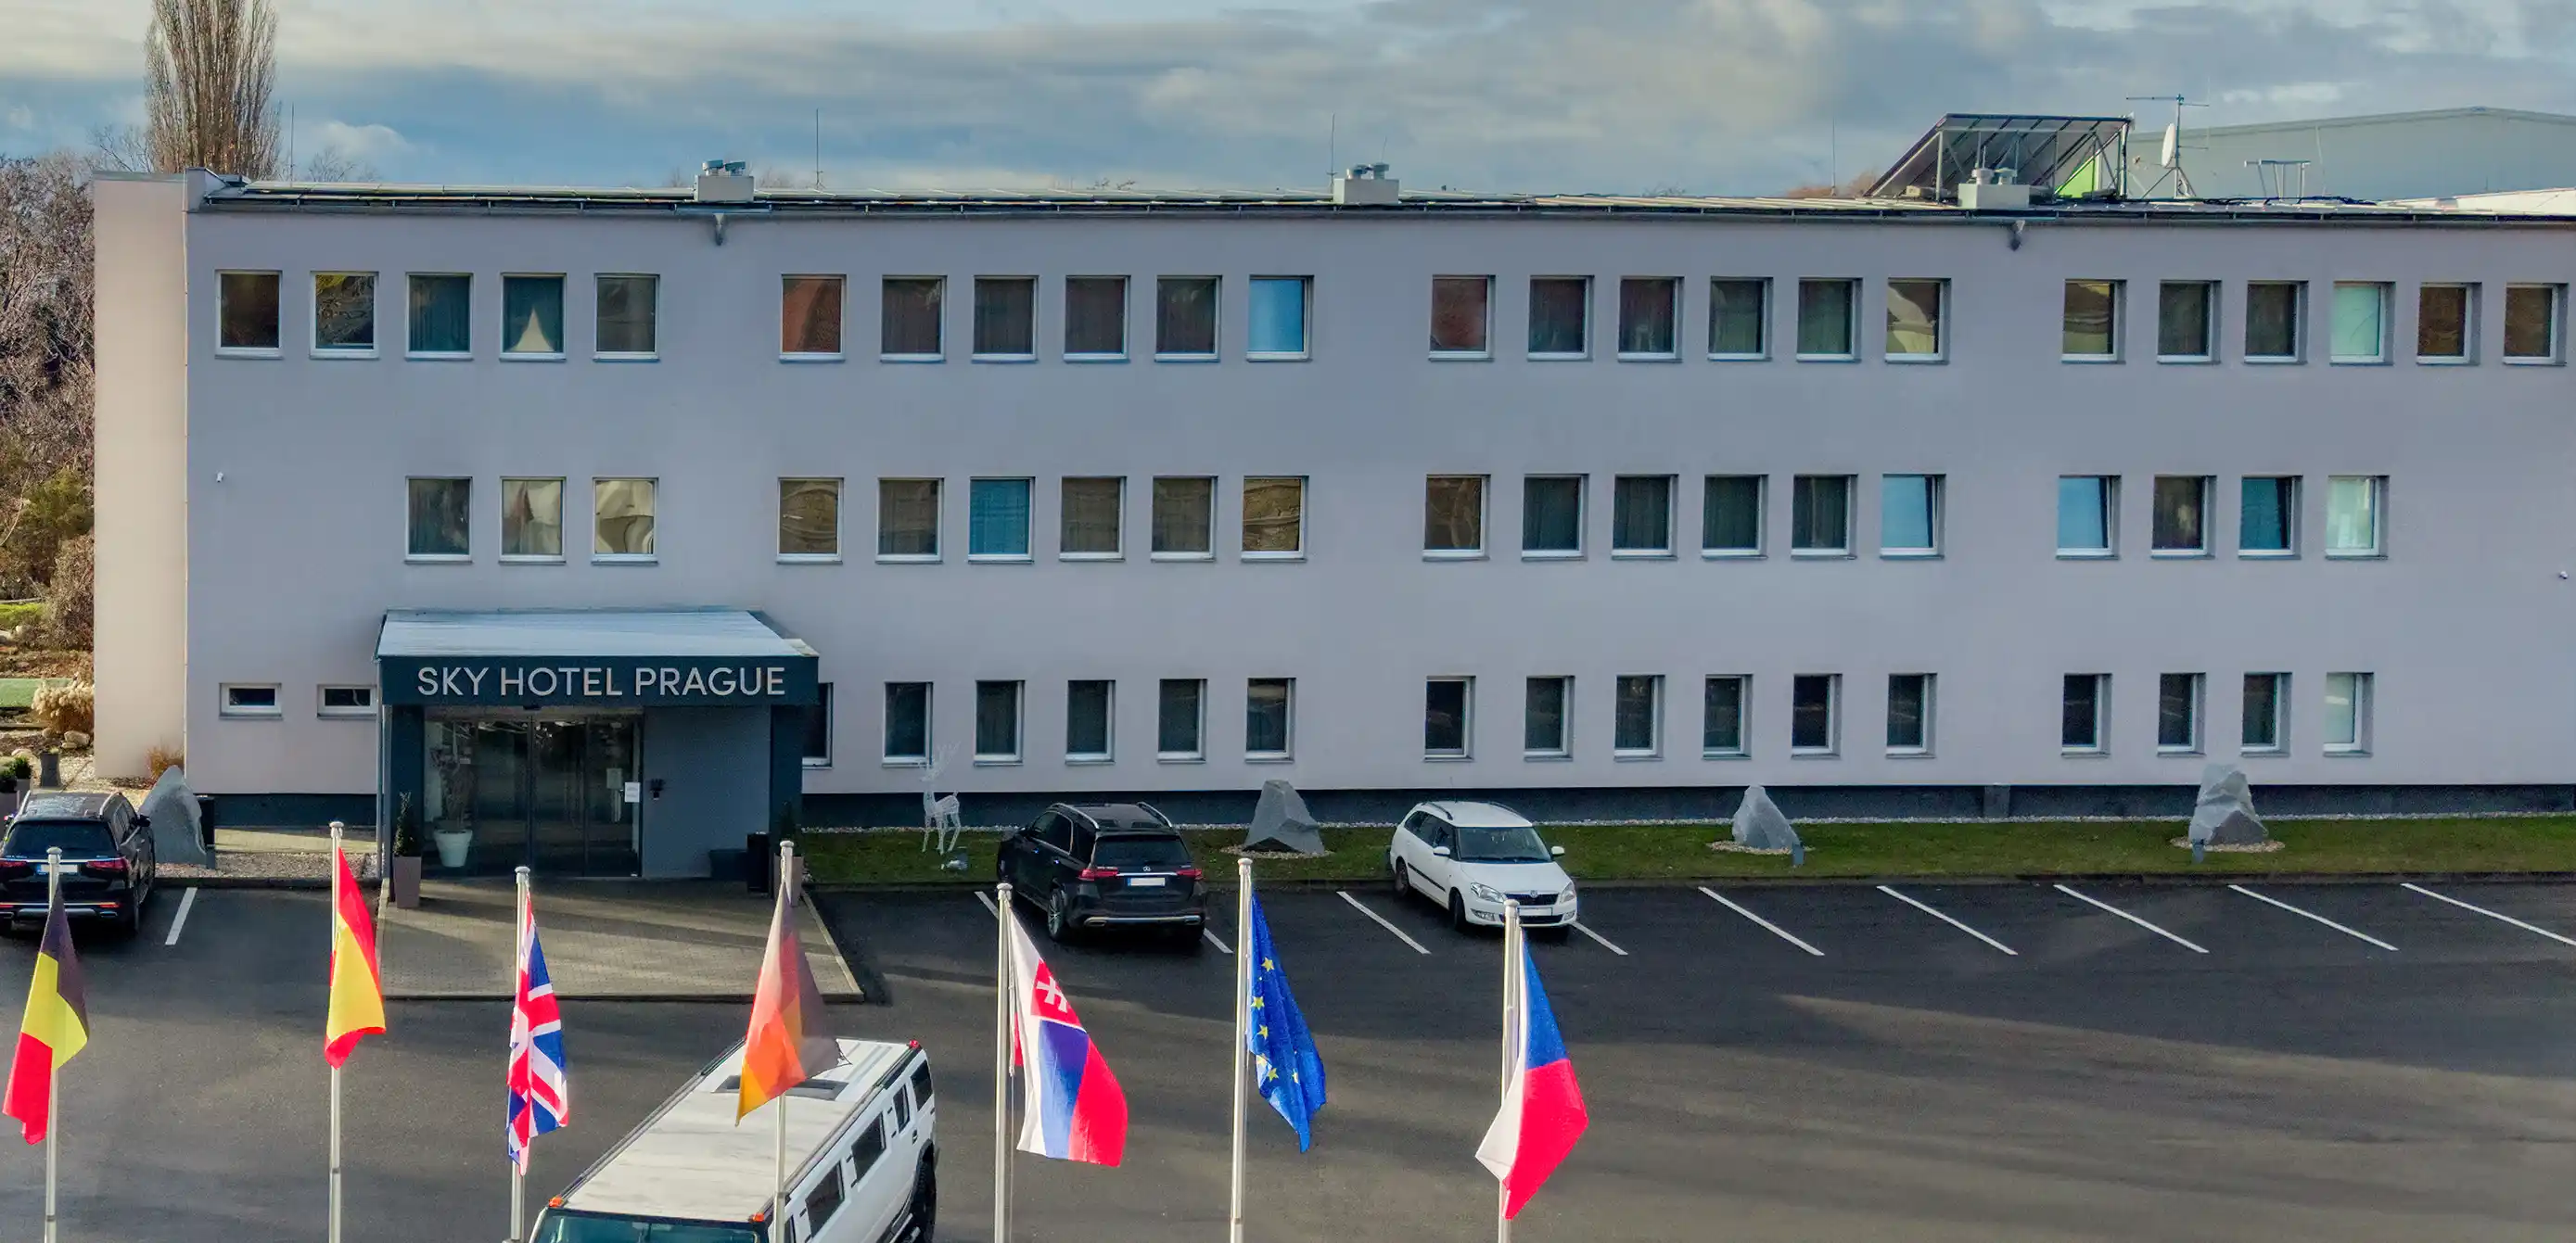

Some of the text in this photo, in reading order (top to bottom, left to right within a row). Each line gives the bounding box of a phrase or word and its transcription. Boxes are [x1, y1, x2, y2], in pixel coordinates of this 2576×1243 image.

[417, 666, 785, 696] SKY HOTEL PRAGUE
